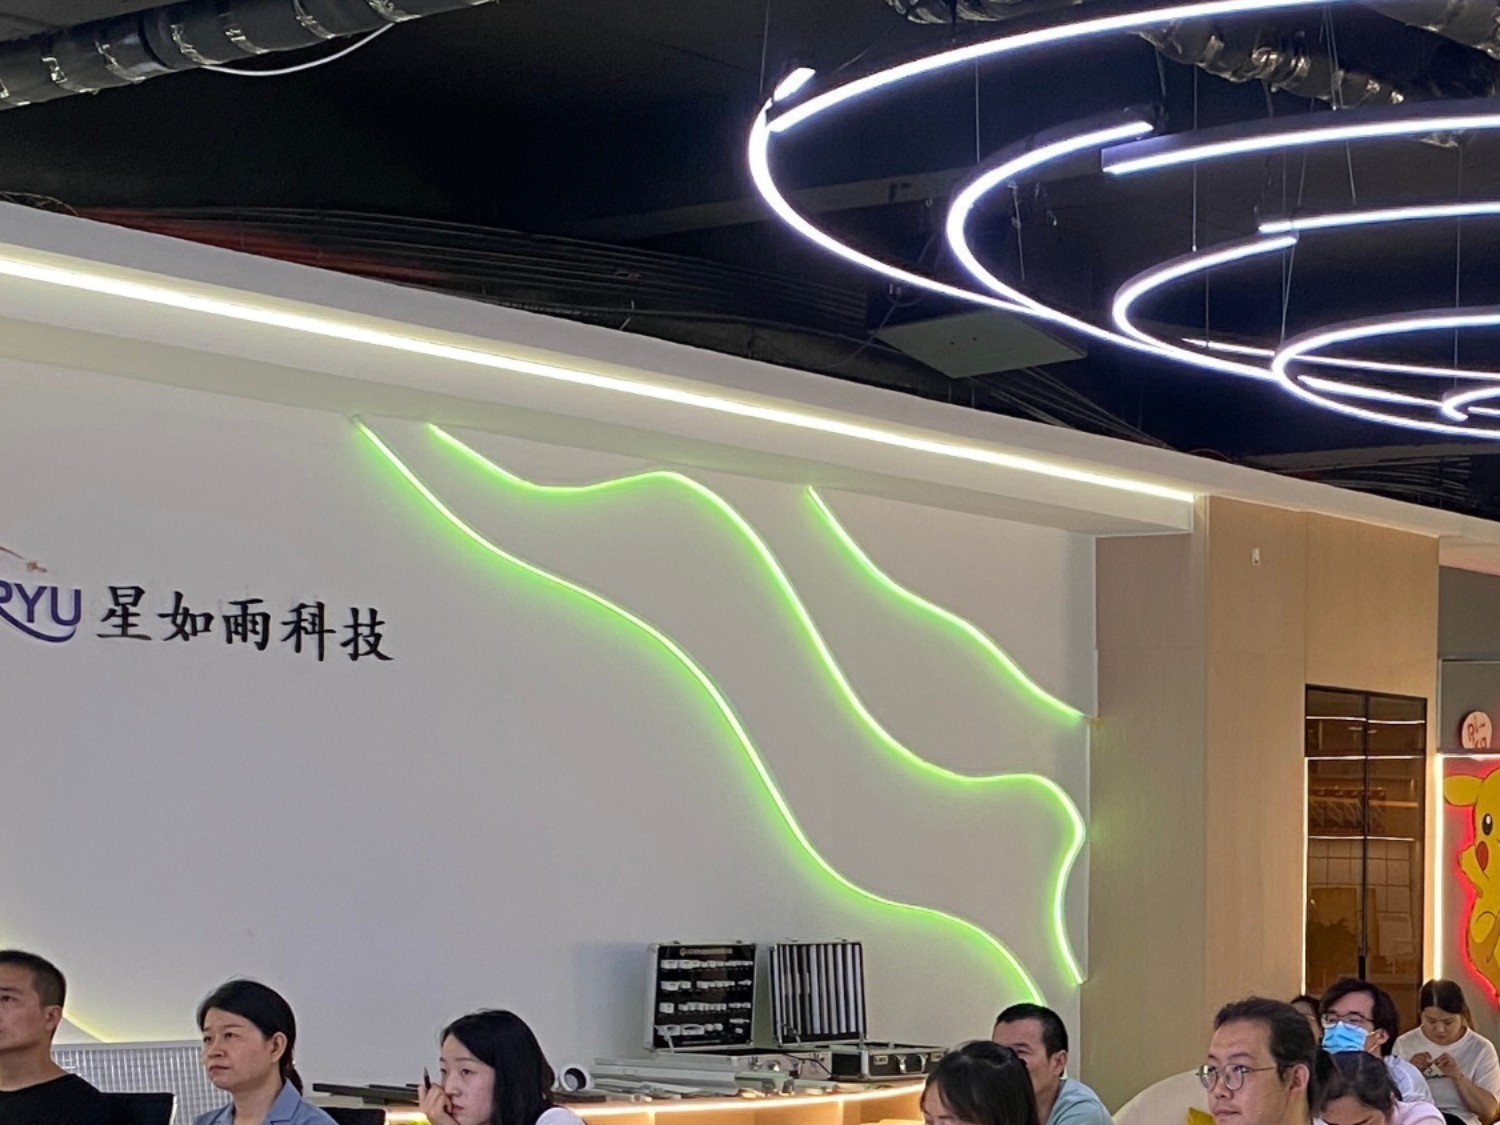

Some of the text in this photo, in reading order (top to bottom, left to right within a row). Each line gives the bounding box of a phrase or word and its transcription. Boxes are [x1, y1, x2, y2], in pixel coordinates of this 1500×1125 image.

[97, 585, 393, 662] 星如雨科技
